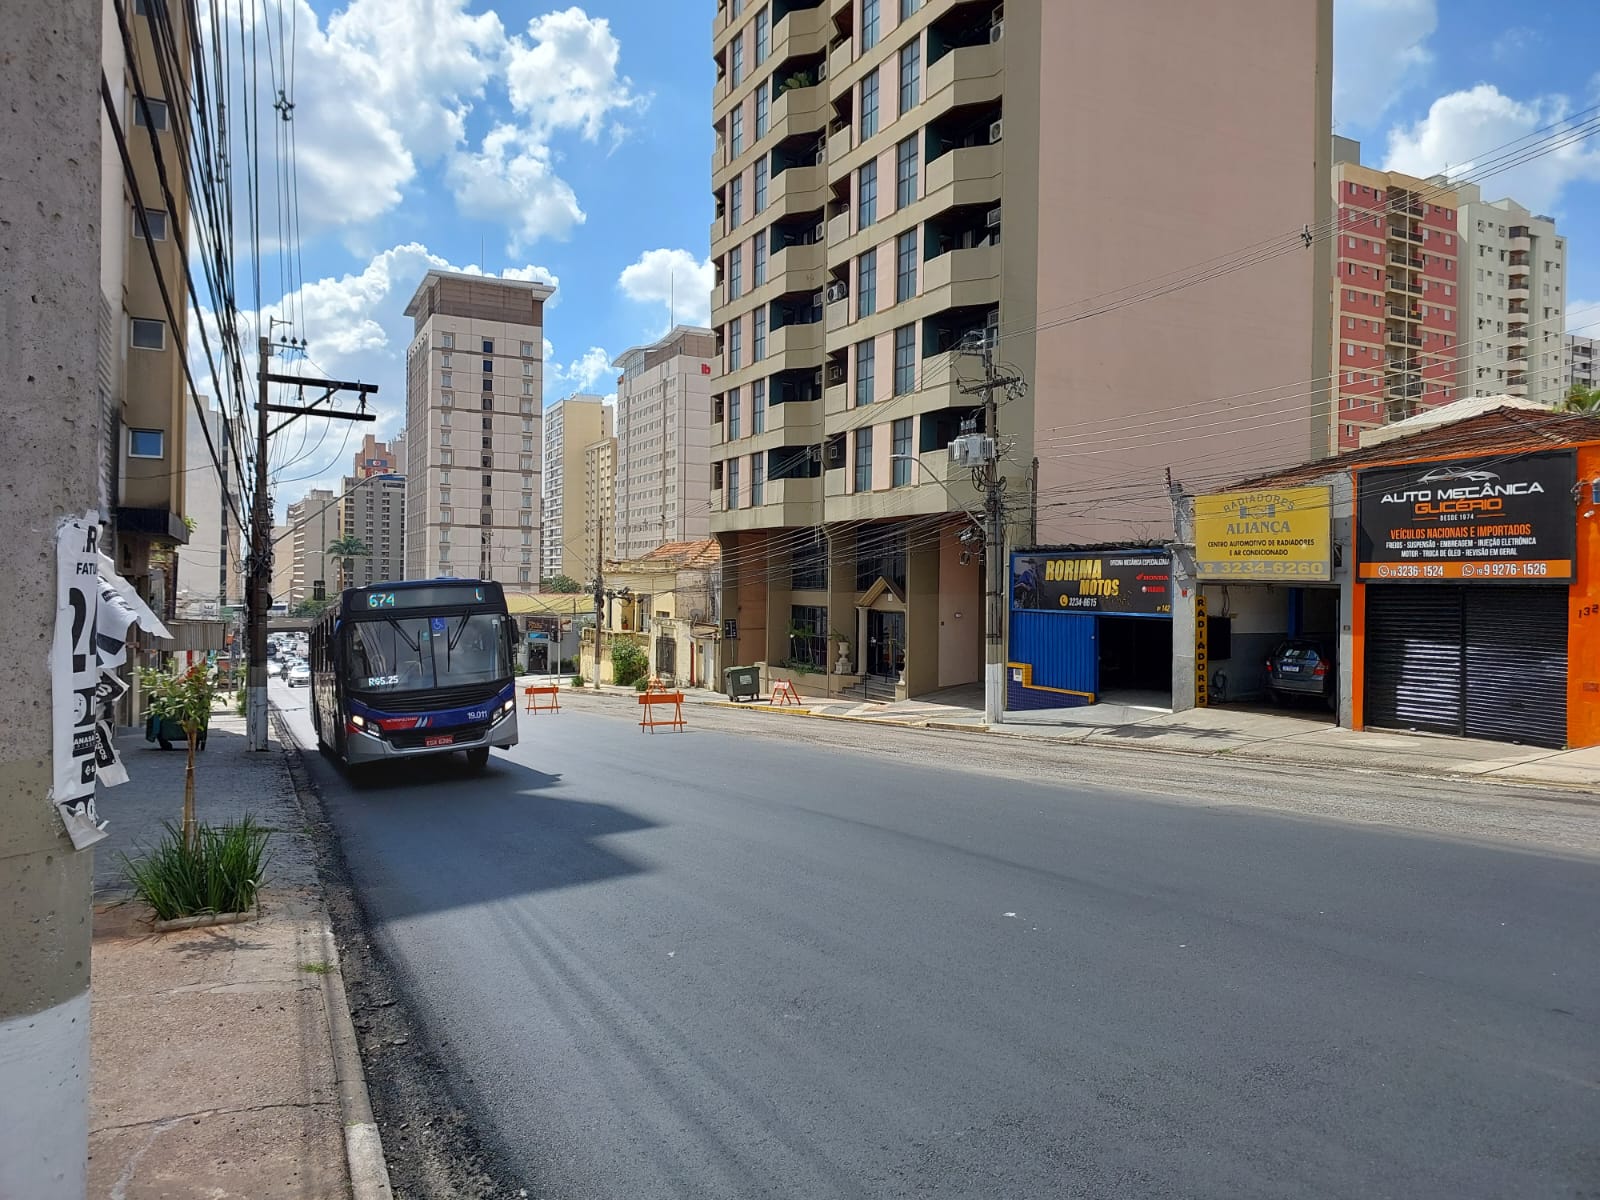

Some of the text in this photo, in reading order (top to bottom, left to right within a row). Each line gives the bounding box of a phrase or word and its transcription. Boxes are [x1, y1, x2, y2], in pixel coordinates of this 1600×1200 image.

[1381, 482, 1544, 503] AUTO MECÂNICA
[1223, 494, 1295, 513] RADIADORES
[1415, 498, 1502, 514] GLICÉRIO
[1440, 513, 1458, 521] DESDE
[1226, 521, 1291, 536] ALIANÇA
[1390, 523, 1532, 540] VEÍCULOS NACIONAIS E IMPORTADOS
[1276, 538, 1315, 546] RADIADORES
[1385, 535, 1536, 549] FREIOS SUSPENSÃO EMBREAGEM INJEÇÃO ELETRÔNICA
[1422, 549, 1439, 557] TROCA
[1440, 549, 1447, 557] DE
[1447, 548, 1461, 557] ÓLEO
[1465, 547, 1489, 557] REVISÃO
[1489, 548, 1498, 556] EM
[1499, 547, 1518, 556] GERAL
[1045, 560, 1102, 581] RORIMA
[1221, 562, 1324, 574] 3234-6260
[1484, 565, 1490, 575] 9
[1079, 579, 1120, 596] MOTOS
[369, 593, 395, 608] 674
[1578, 604, 1599, 618] 132
[1197, 599, 1206, 704] RADIADORES
